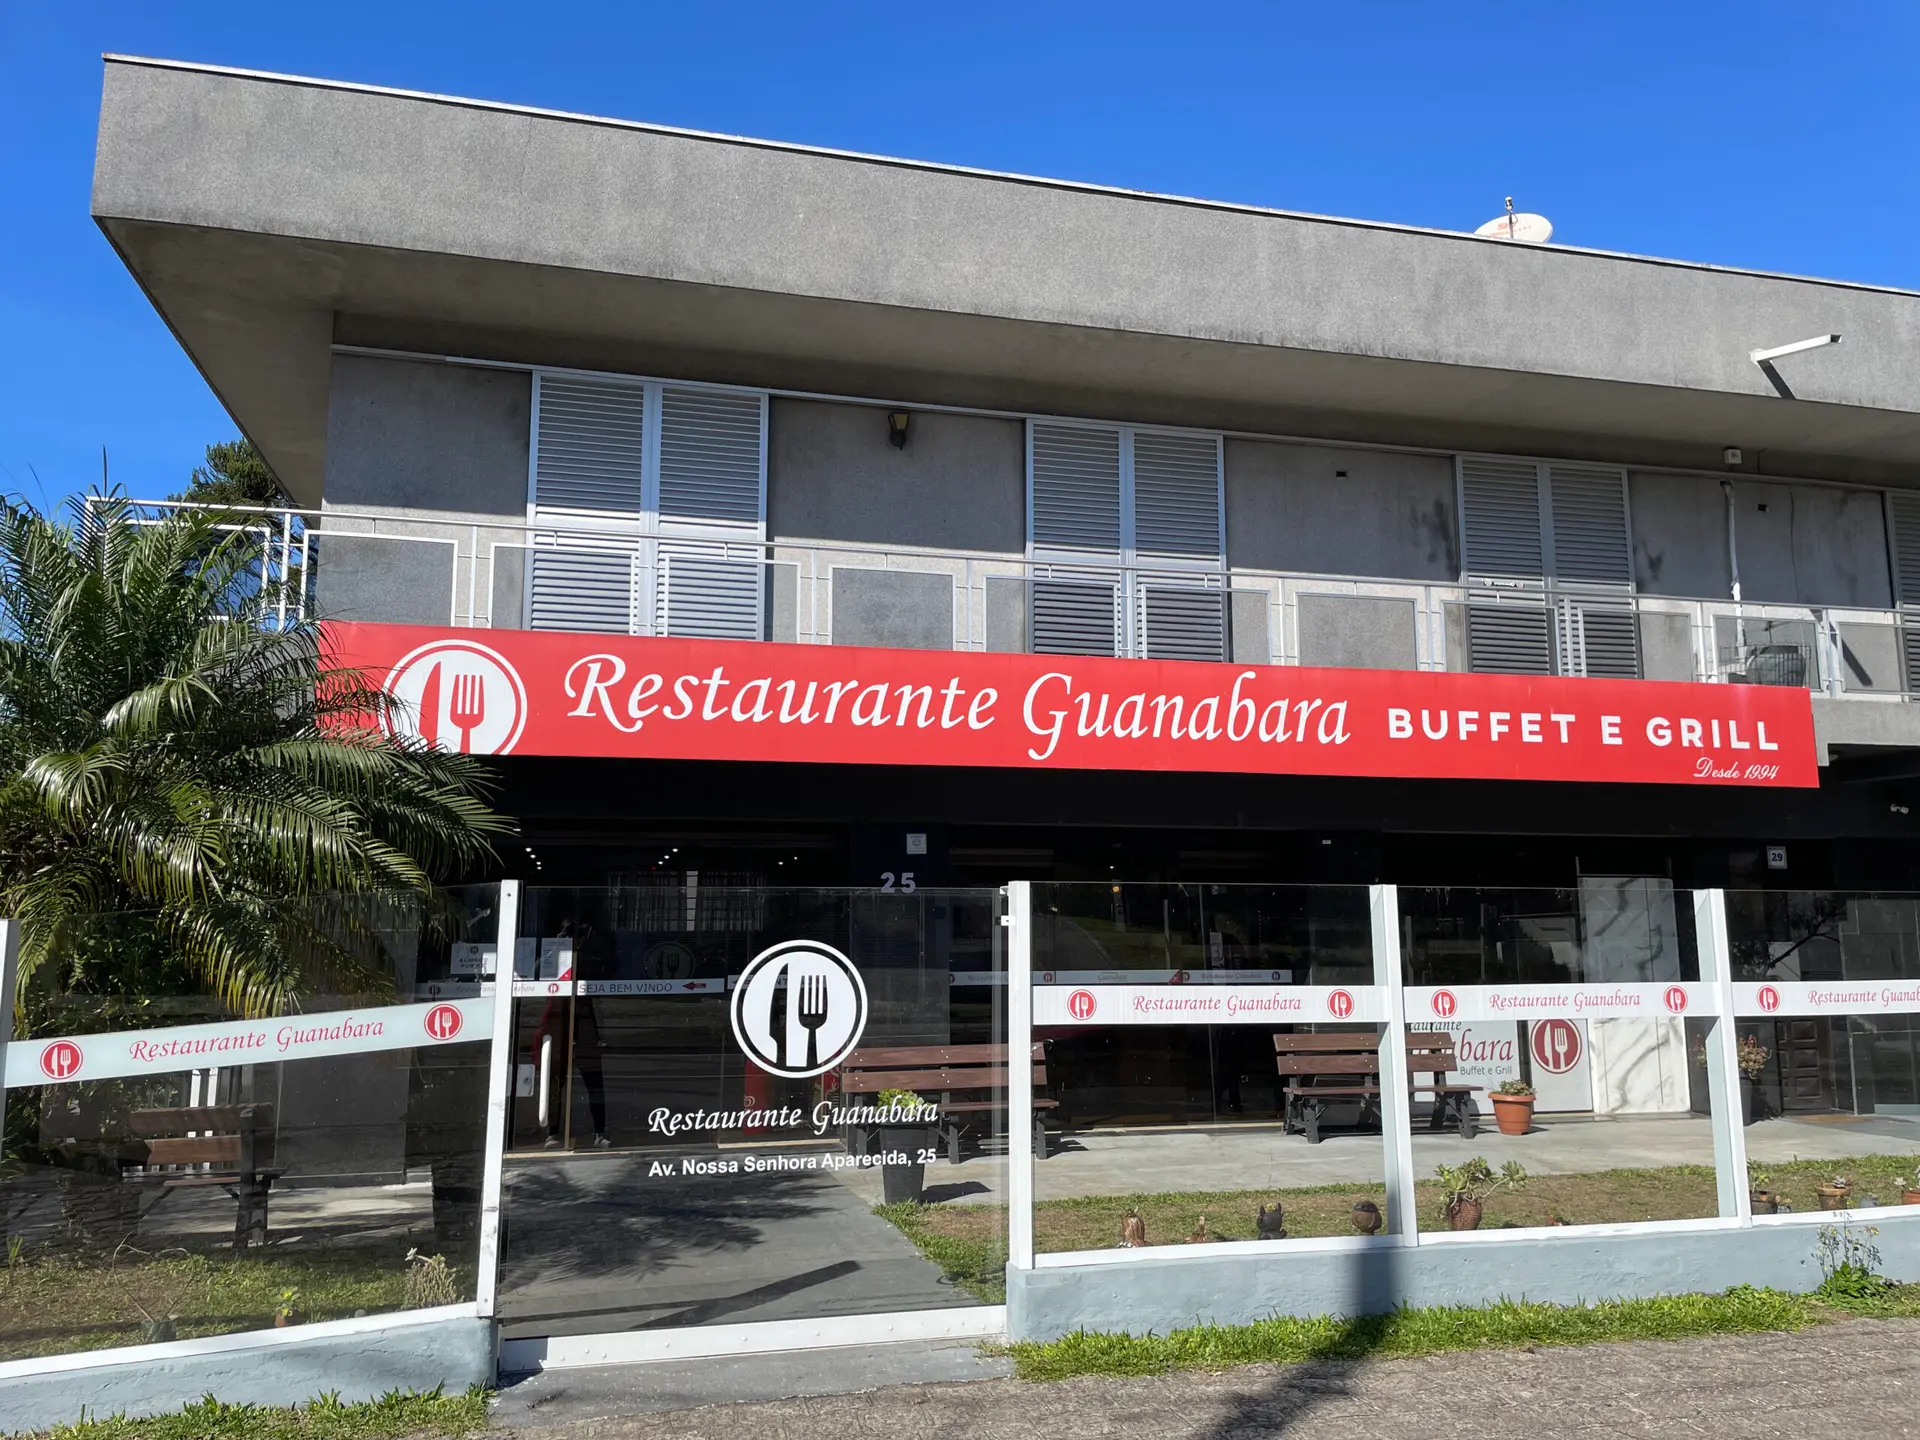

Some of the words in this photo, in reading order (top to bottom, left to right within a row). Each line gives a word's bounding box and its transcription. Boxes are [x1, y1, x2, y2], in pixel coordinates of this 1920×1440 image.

[564, 653, 999, 733] Restaurante
[1022, 671, 1352, 762] Guanabara
[1387, 707, 1576, 744] BUFFET
[1601, 716, 1623, 745] E
[1645, 716, 1779, 751] GRILL
[1693, 756, 1740, 779] Desde
[1743, 764, 1780, 780] 1994
[1771, 852, 1783, 862] 29
[880, 871, 916, 894] 25
[579, 983, 606, 994] SEJA
[609, 983, 632, 993] BEM
[636, 982, 673, 993] VINDO
[1489, 994, 1568, 1009] Restaurante
[1573, 988, 1641, 1012] Guanabara
[1809, 991, 1876, 1005] Restaurante
[1134, 995, 1220, 1013] Restaurante
[1227, 991, 1302, 1016] Guanabara
[130, 1032, 266, 1062] Restaurante
[275, 1017, 384, 1053] Guanabara
[1460, 1066, 1485, 1076] Buffet
[1495, 1065, 1512, 1074] Grill
[648, 1107, 801, 1136] Restaurante
[811, 1094, 939, 1136] Guanabara
[648, 1160, 677, 1178] Av.
[682, 1157, 739, 1176] Nossa
[743, 1154, 817, 1174] Senhora
[821, 1150, 912, 1173] Aparecida,
[916, 1148, 937, 1164] 25
